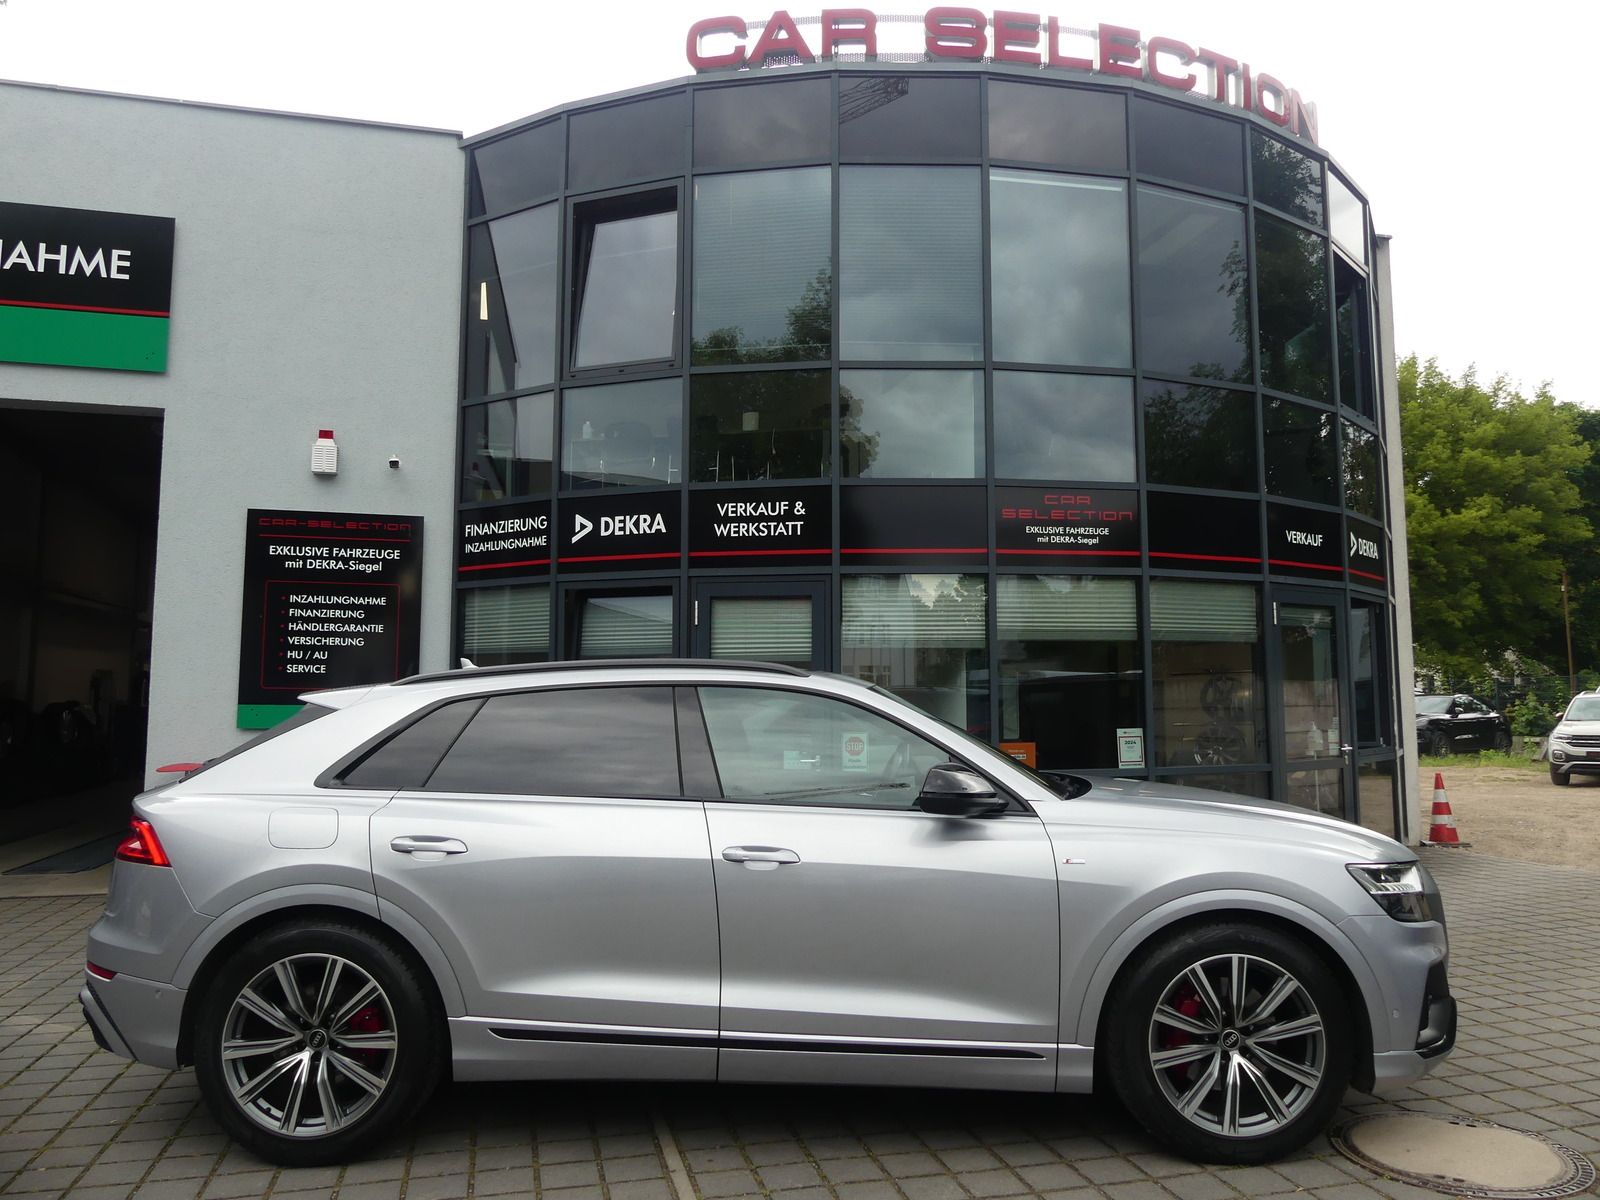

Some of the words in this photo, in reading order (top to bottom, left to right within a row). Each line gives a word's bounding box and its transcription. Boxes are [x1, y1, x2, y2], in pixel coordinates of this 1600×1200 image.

[686, 8, 878, 72] CAR
[924, 6, 1319, 143] SELECTION
[716, 501, 789, 517] VERKAUF
[793, 501, 806, 516] &
[1001, 508, 1133, 521] SELECTION
[465, 515, 548, 538] FINANZIERUNG
[600, 513, 667, 537] DEKRA
[713, 521, 804, 538] WERKSTATT
[1025, 526, 1065, 535] EXKLUSIVE
[1066, 527, 1110, 536] FAHRZEUGE
[465, 535, 547, 554] INZAHLUNGNAHME
[1037, 535, 1049, 544] mit
[1050, 536, 1099, 546] DEKRA-Siegel
[1285, 529, 1323, 547] VERKAUF
[269, 545, 330, 558] EXKLUSIVE
[332, 547, 401, 560] FAHRZEUGE
[1358, 538, 1379, 560] DEKRA
[285, 559, 303, 569] mit
[306, 559, 383, 574] DEKRA-Siegel
[289, 594, 387, 606] INZAHLUNGNAHME
[289, 608, 365, 619] FINANZIERUNG
[288, 621, 384, 633] HÄNDLERGARANTIE
[287, 636, 365, 647] VERSICHERUNG
[287, 650, 303, 660] HU
[313, 651, 328, 660] AU
[286, 664, 327, 674] SERVICE
[846, 742, 864, 751] STOP
